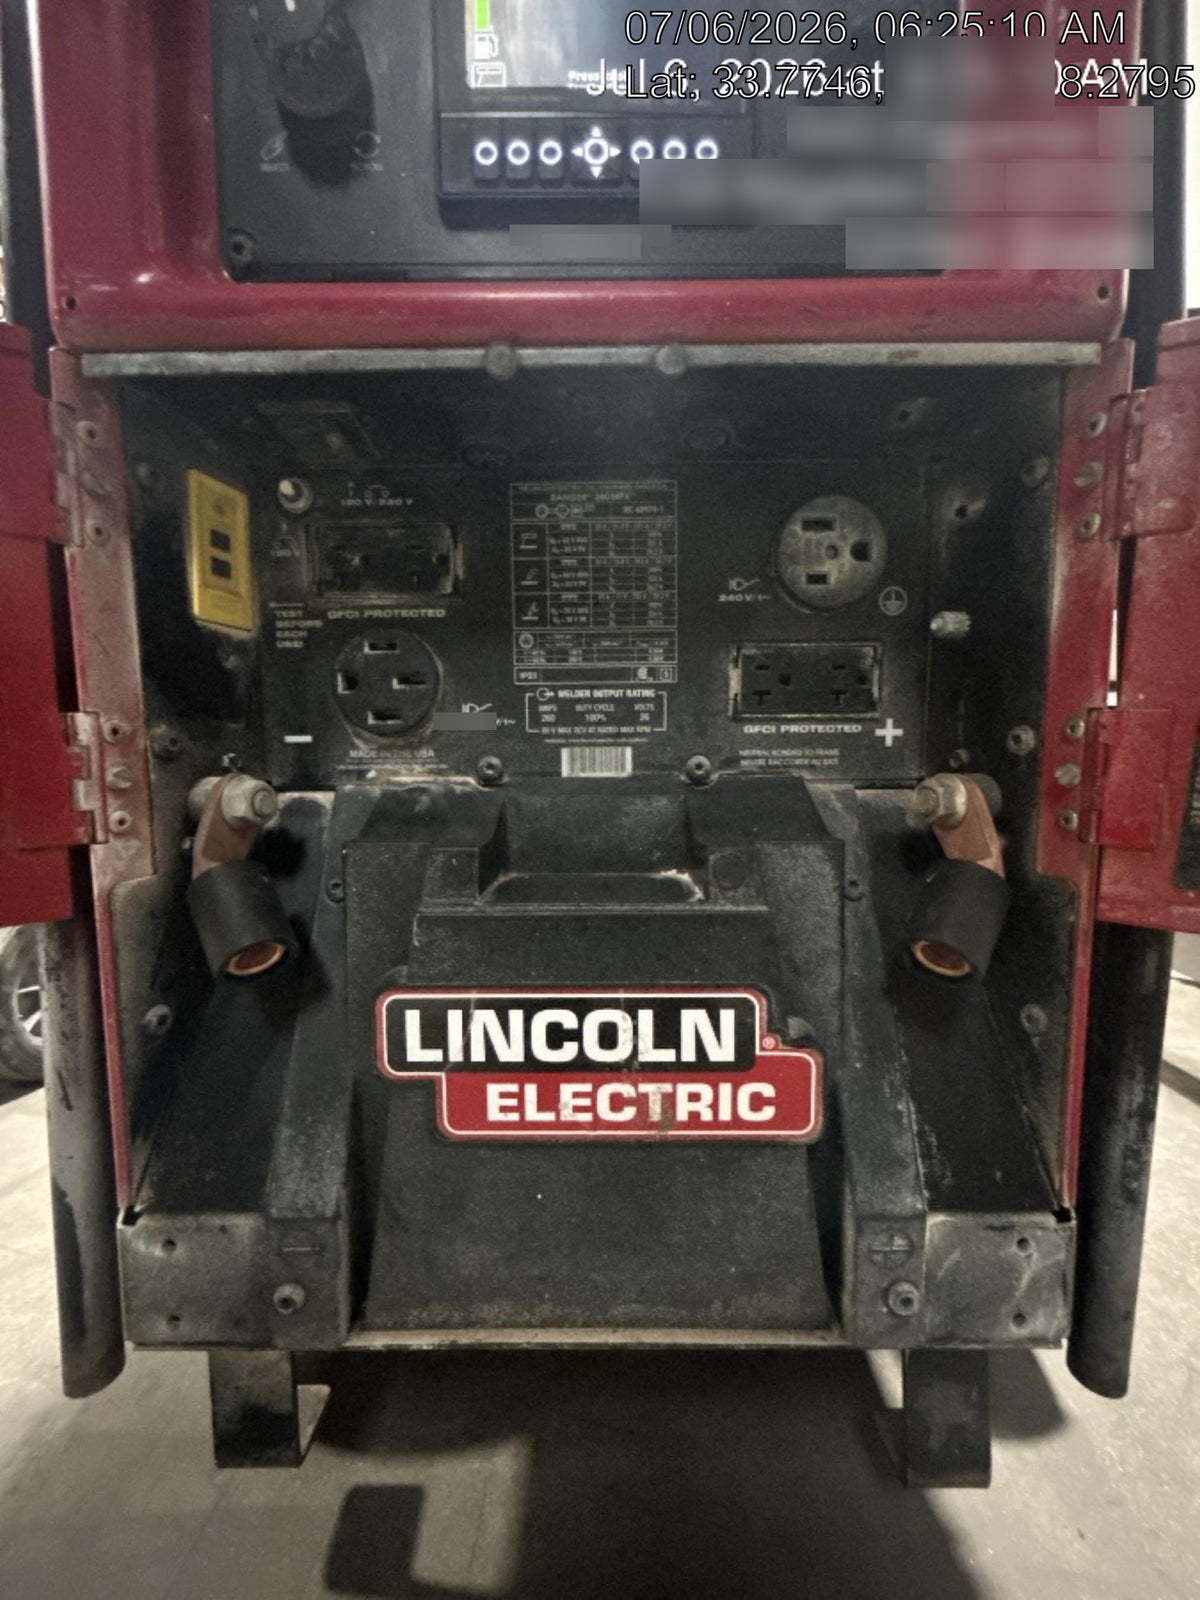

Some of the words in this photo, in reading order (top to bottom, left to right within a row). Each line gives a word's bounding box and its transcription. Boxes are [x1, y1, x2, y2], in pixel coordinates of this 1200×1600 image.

[327, 608, 360, 620] GFCI
[363, 608, 447, 619] PROTECTED
[593, 688, 624, 698] OUTPUT
[625, 688, 656, 697] RATING
[743, 724, 776, 734] GFCI
[780, 724, 863, 733] PROTECTED
[404, 1008, 735, 1063] LINCOLN
[486, 1082, 776, 1122] ELECTRIC
